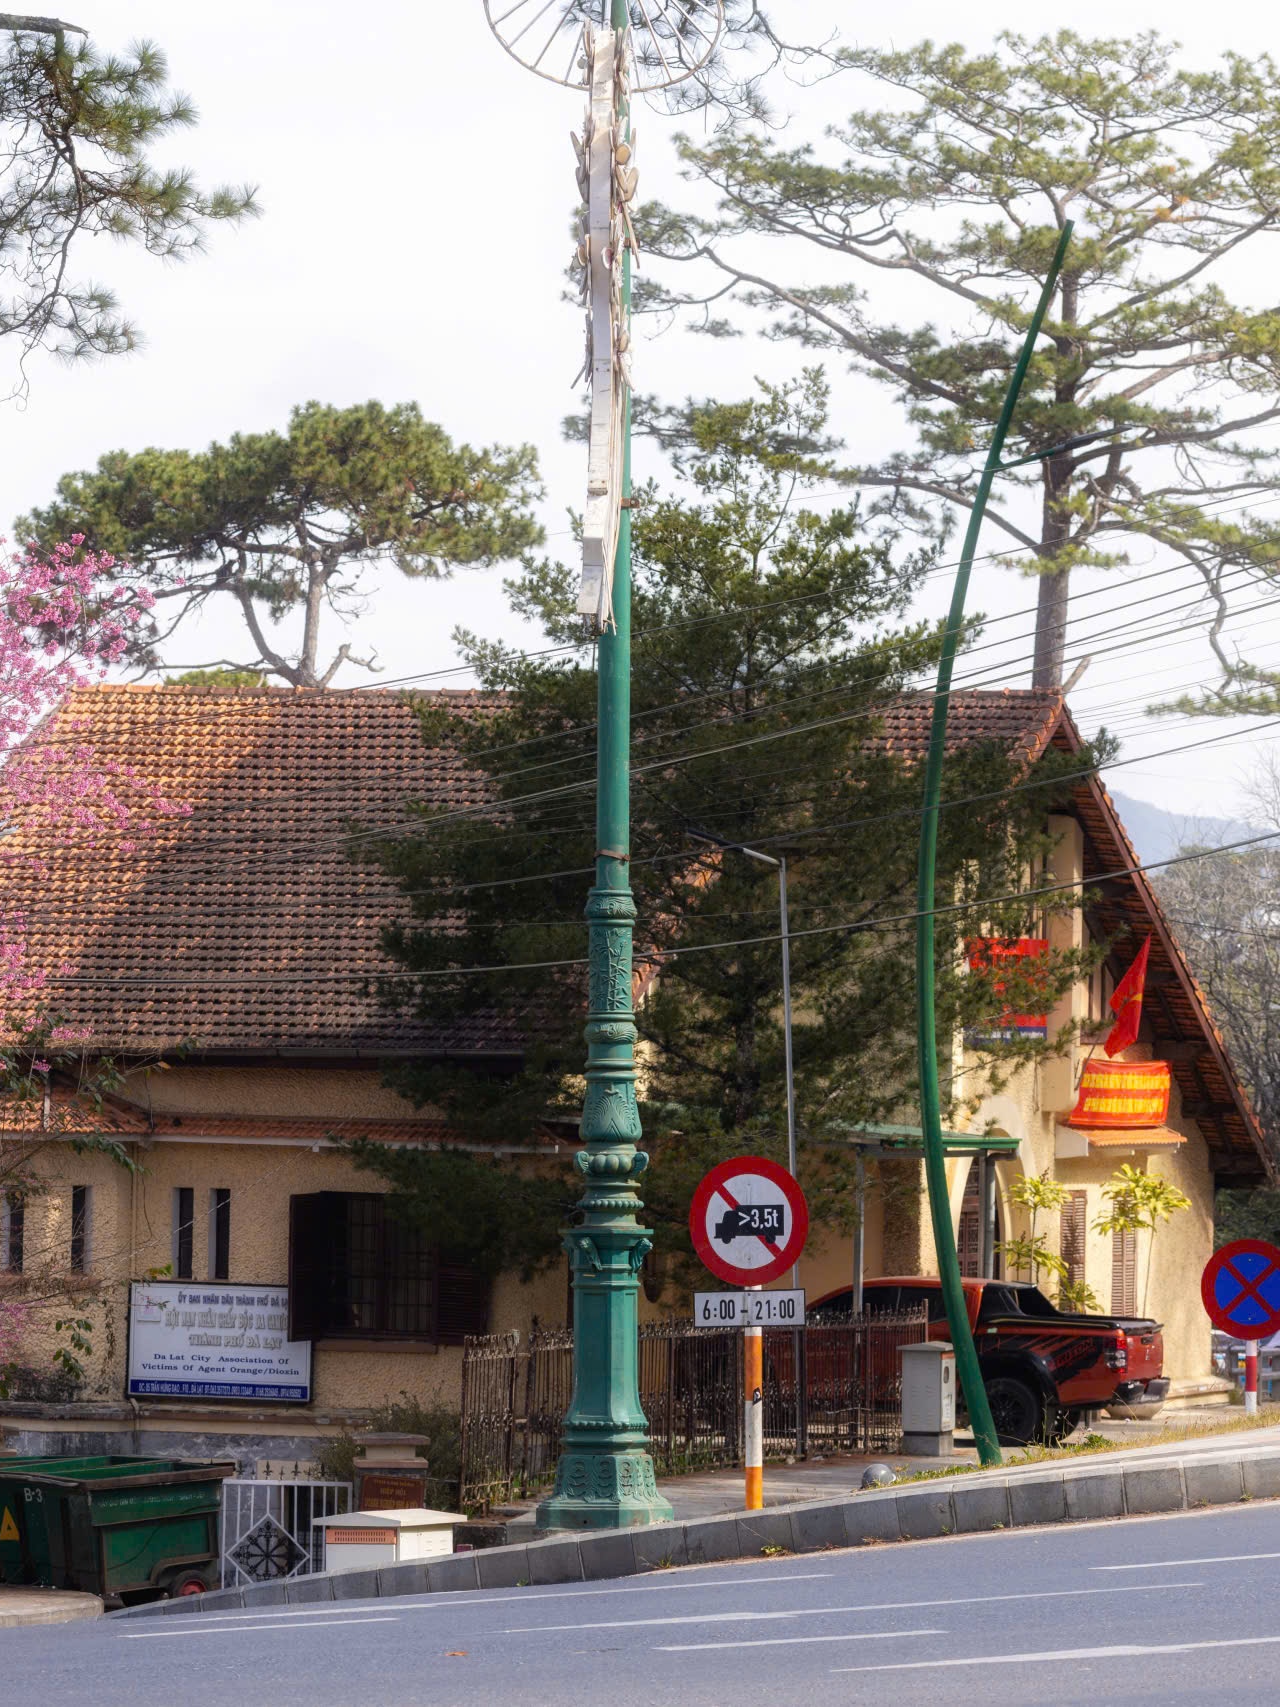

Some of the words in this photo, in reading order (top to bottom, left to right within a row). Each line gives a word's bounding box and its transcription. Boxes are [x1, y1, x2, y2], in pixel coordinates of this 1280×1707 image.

[738, 1208, 778, 1229] >3,5t
[189, 1294, 200, 1304] BAN
[702, 1299, 736, 1320] 6:00
[755, 1298, 795, 1320] 21:00
[191, 1354, 211, 1363] City
[218, 1355, 273, 1364] Association
[142, 1363, 178, 1371] Victims
[198, 1365, 225, 1373] Agent
[230, 1366, 300, 1376] Orange/Dioxin
